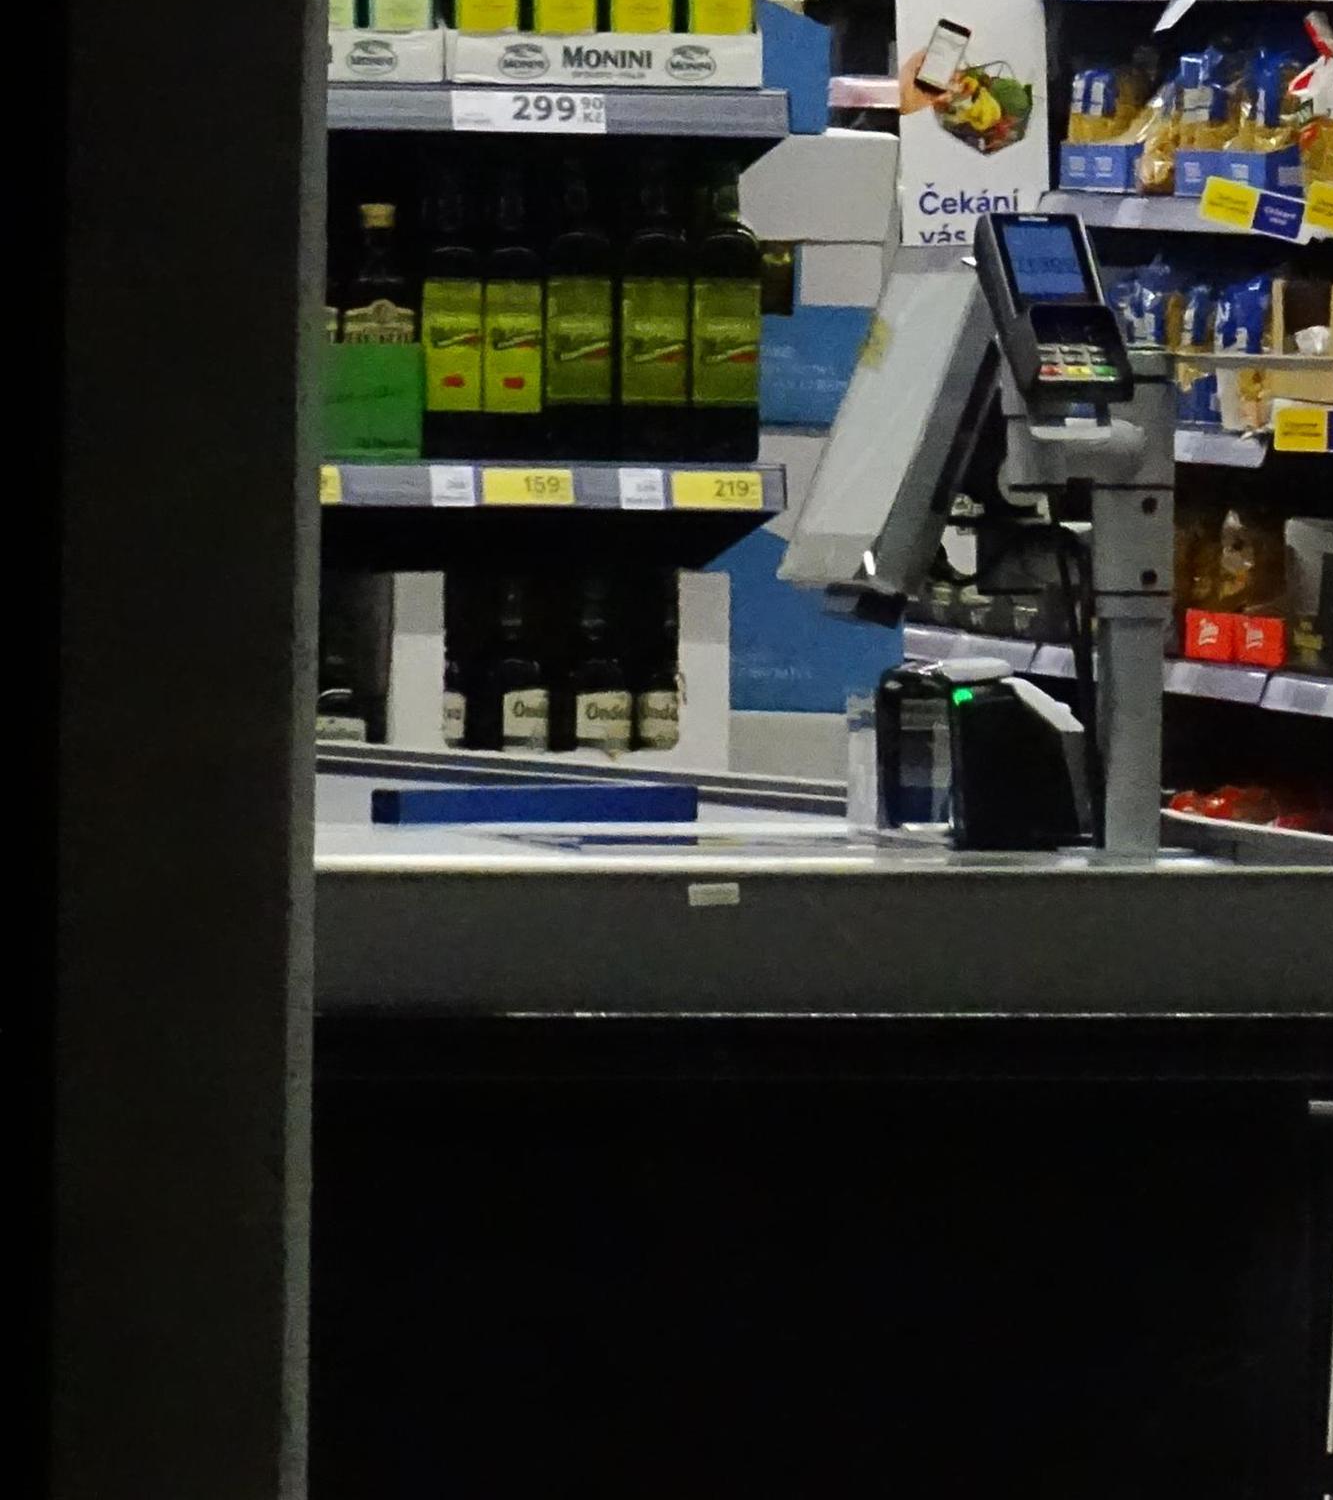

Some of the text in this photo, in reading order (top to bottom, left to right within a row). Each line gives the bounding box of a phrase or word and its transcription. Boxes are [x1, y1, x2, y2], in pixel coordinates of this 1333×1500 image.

[561, 45, 653, 70] MONINI
[511, 95, 577, 122] 299
[918, 182, 1020, 217] Čekání
[524, 476, 560, 495] 159
[714, 479, 750, 498] 219
